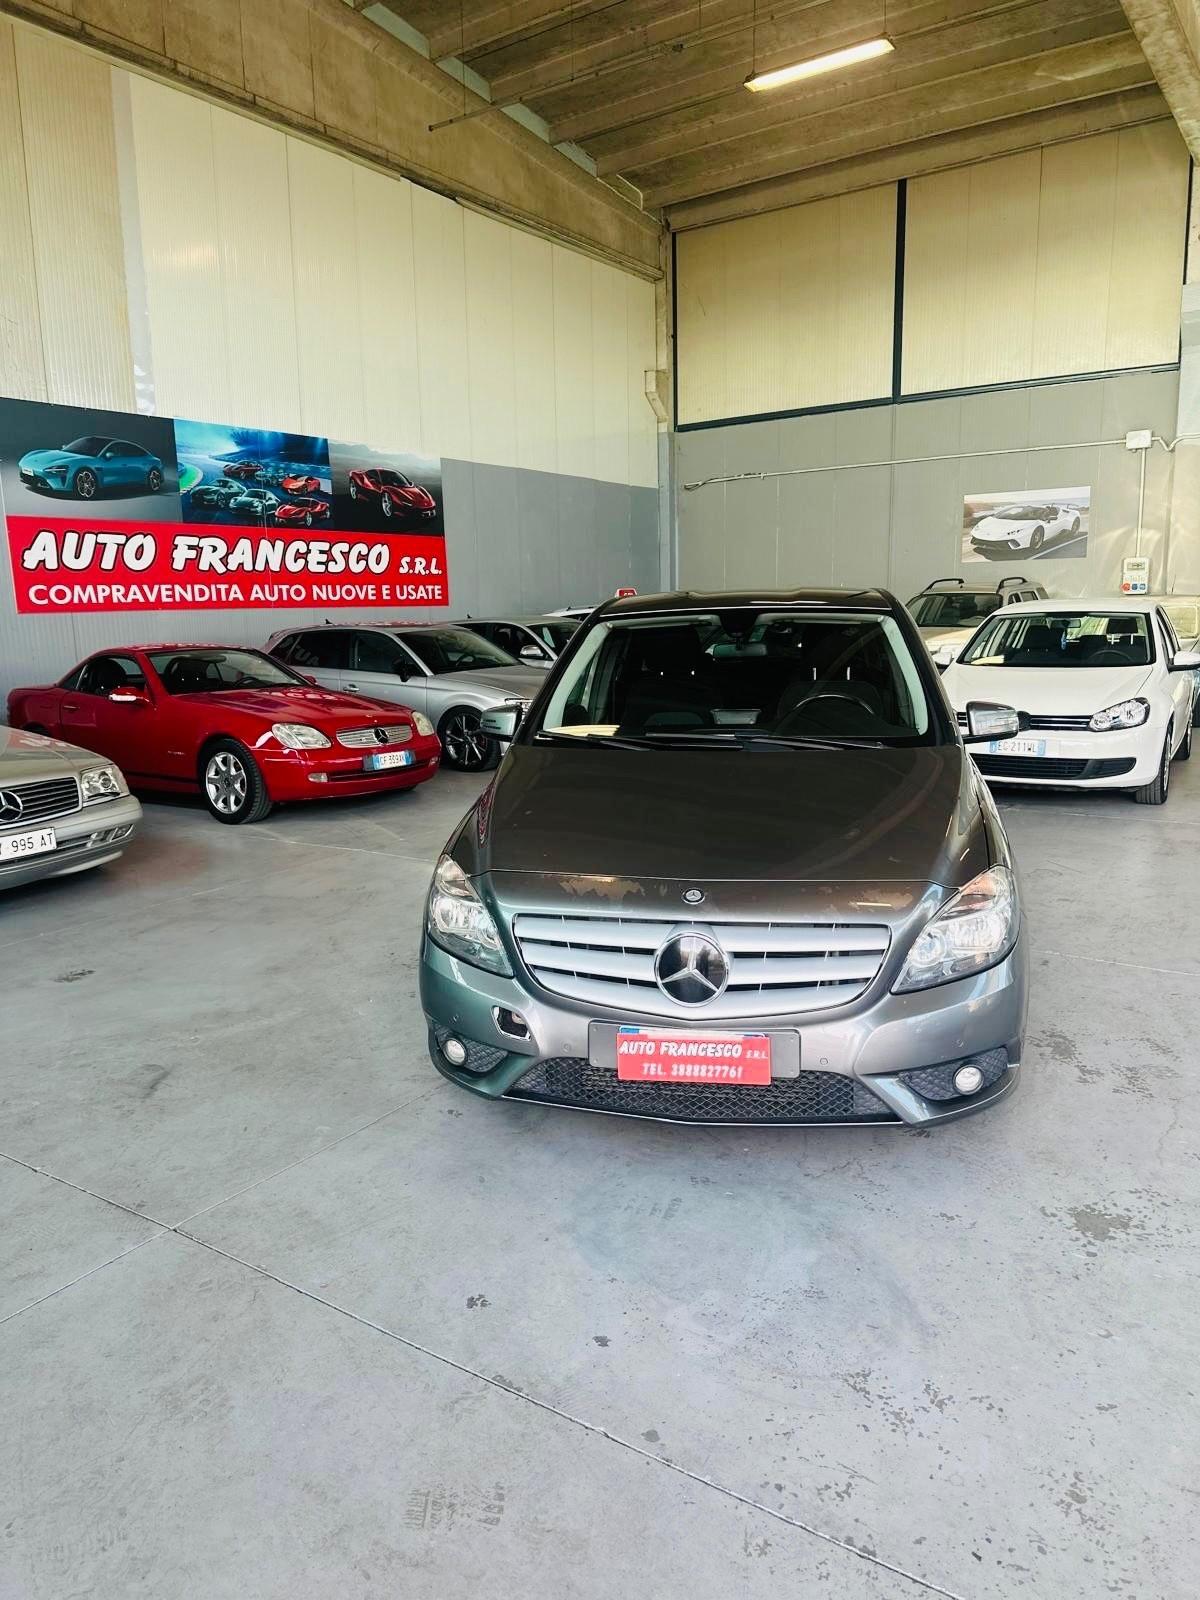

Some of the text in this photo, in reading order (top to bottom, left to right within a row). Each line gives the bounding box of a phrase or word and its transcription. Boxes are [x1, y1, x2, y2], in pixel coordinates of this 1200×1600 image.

[22, 530, 443, 575] AUTO FRANCESCO S.R.L.
[28, 584, 442, 605] COMPRAVENDITA AUTO NUOVE E USATE
[11, 836, 34, 853] 995
[40, 832, 53, 848] AT
[619, 1041, 768, 1059] AUTO FRANCESCO S.R.L.
[642, 1063, 667, 1076] TEL.
